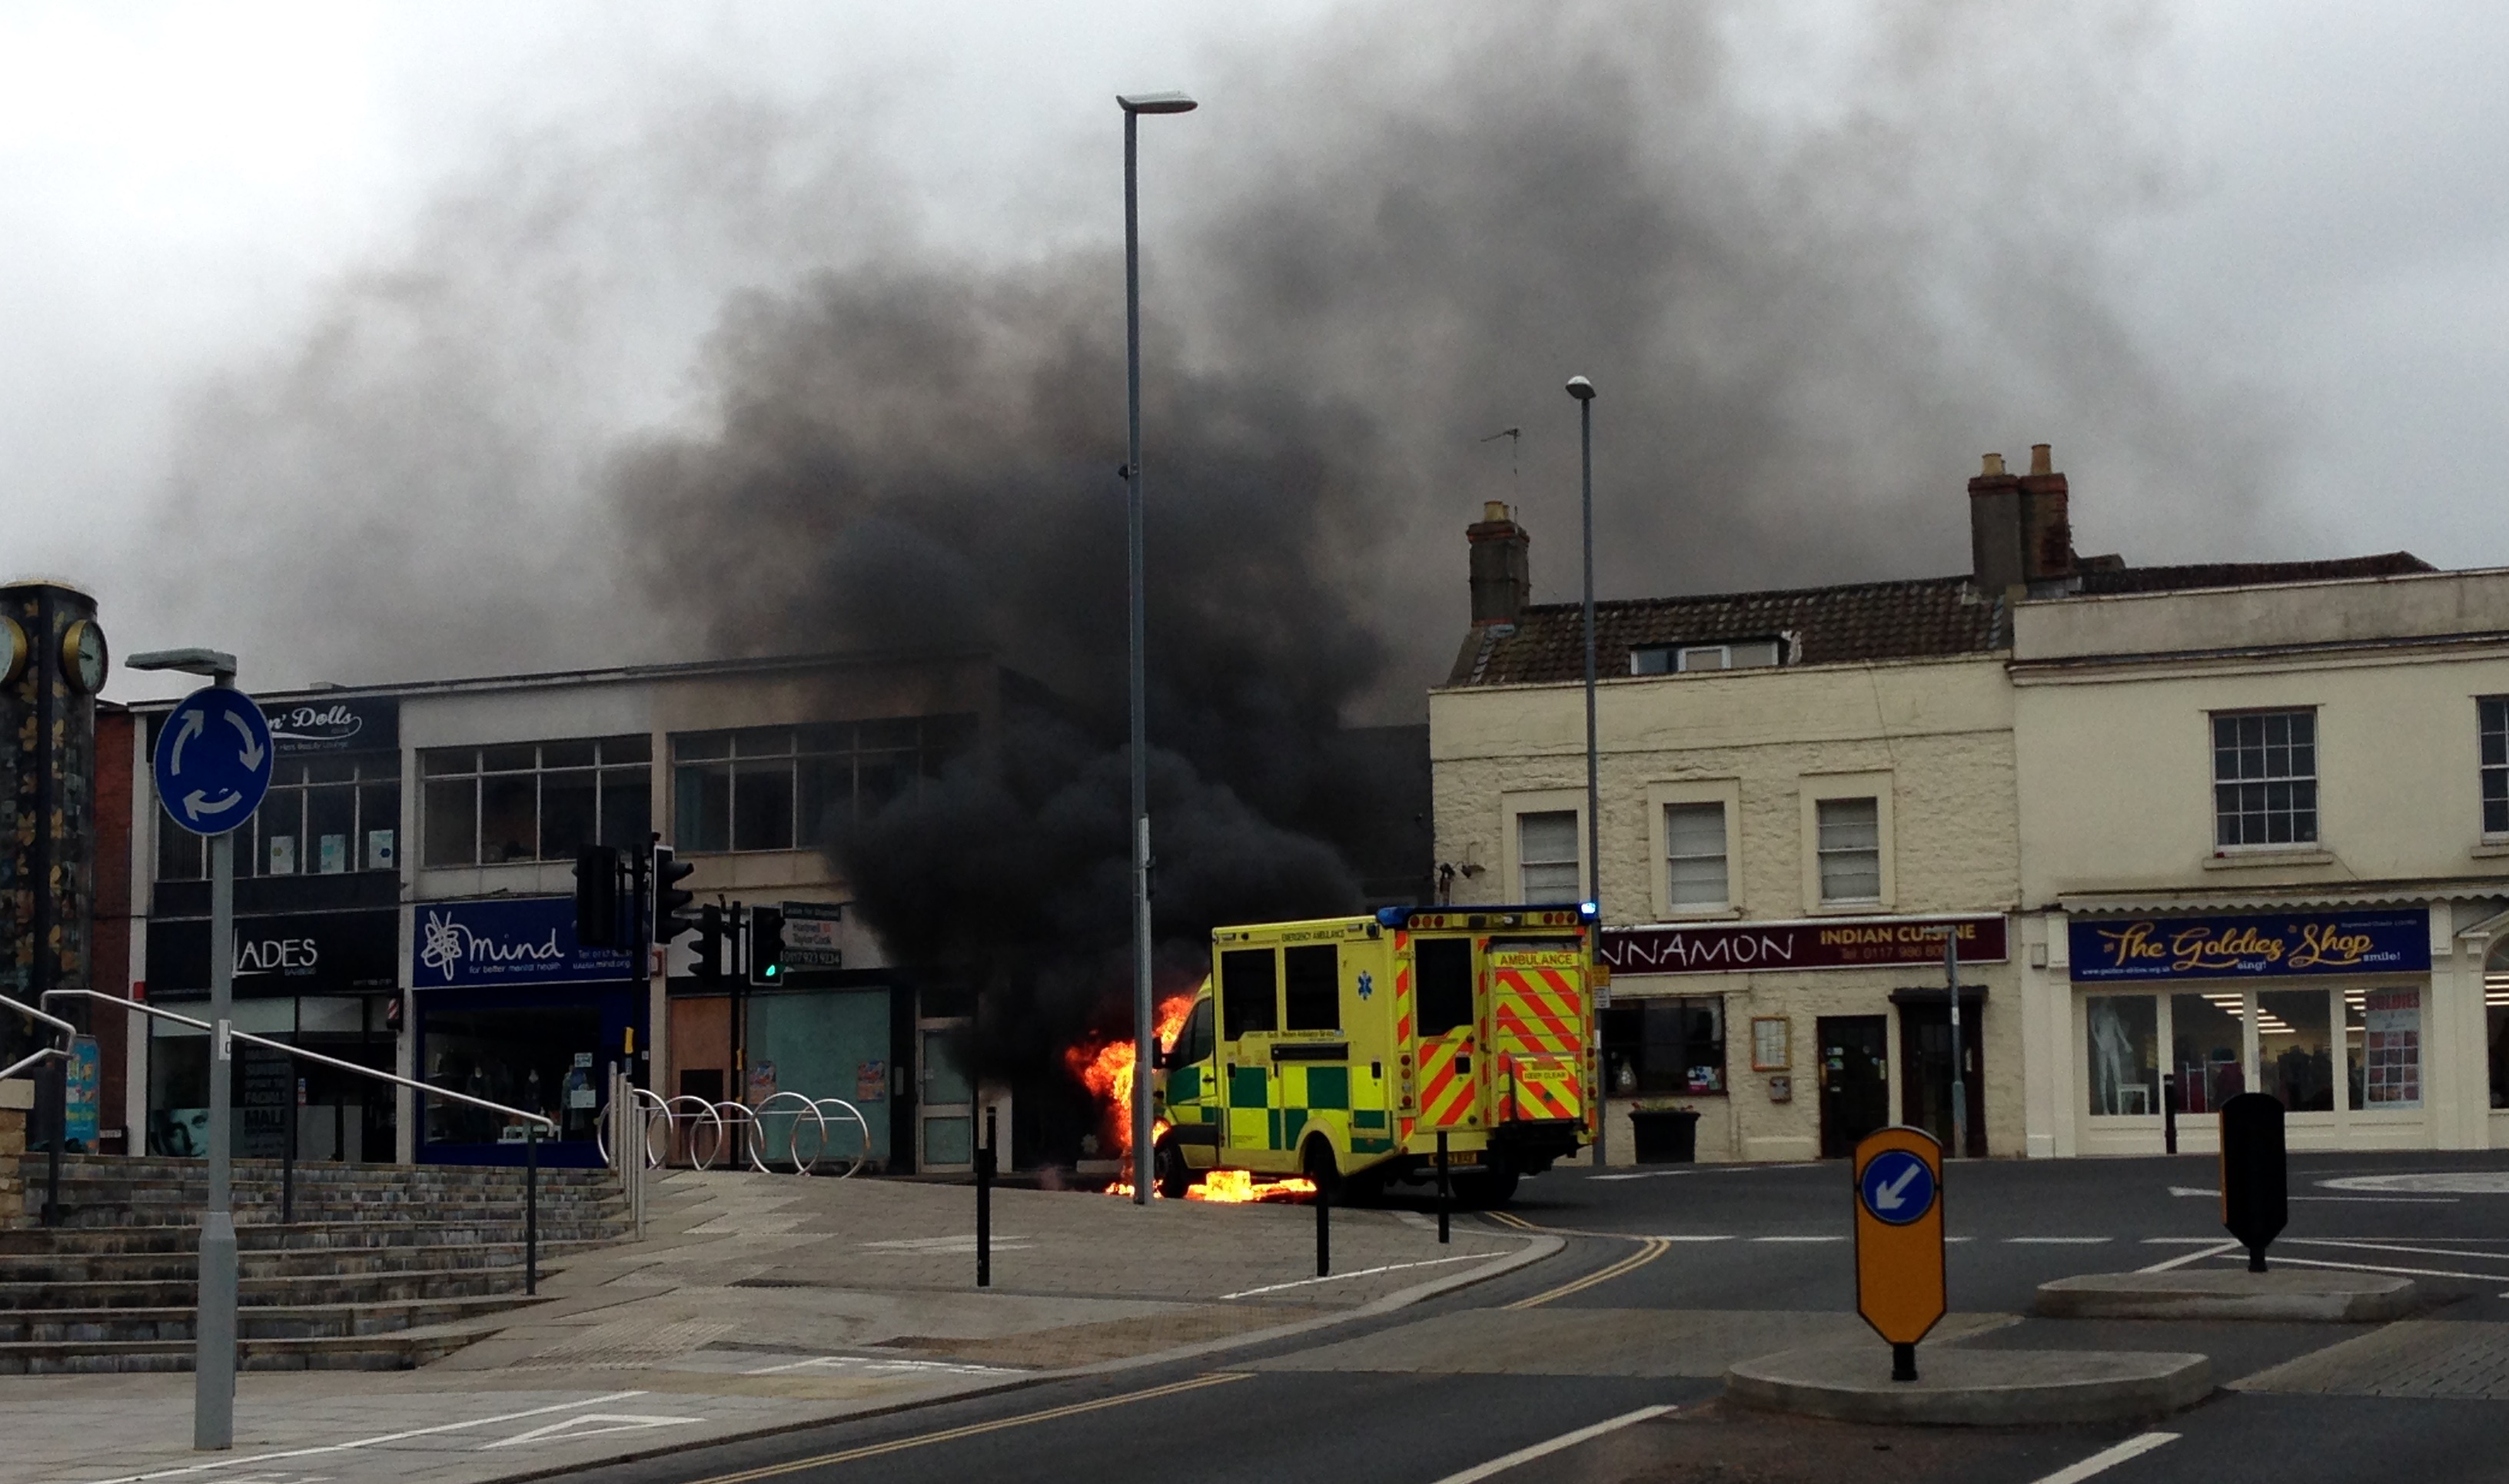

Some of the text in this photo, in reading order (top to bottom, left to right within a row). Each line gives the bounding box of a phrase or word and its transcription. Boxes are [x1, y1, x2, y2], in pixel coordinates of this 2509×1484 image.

[292, 705, 353, 728] Dolls
[1313, 930, 1344, 939] AMBULANCE
[1819, 924, 1976, 945] INDIAN CUSNE
[466, 927, 565, 962] mind
[1600, 933, 1793, 966] NNAMON
[2097, 921, 2374, 971] The Goldies Shop
[232, 928, 319, 979] LADES
[1863, 947, 1893, 959] 0117
[2363, 951, 2401, 962] smile!
[573, 960, 632, 970] www.mind.org
[1500, 954, 1573, 965] AMBULANCE
[2237, 959, 2267, 971] sing!
[469, 965, 481, 974] for
[483, 964, 506, 974] better
[508, 963, 535, 972] mental
